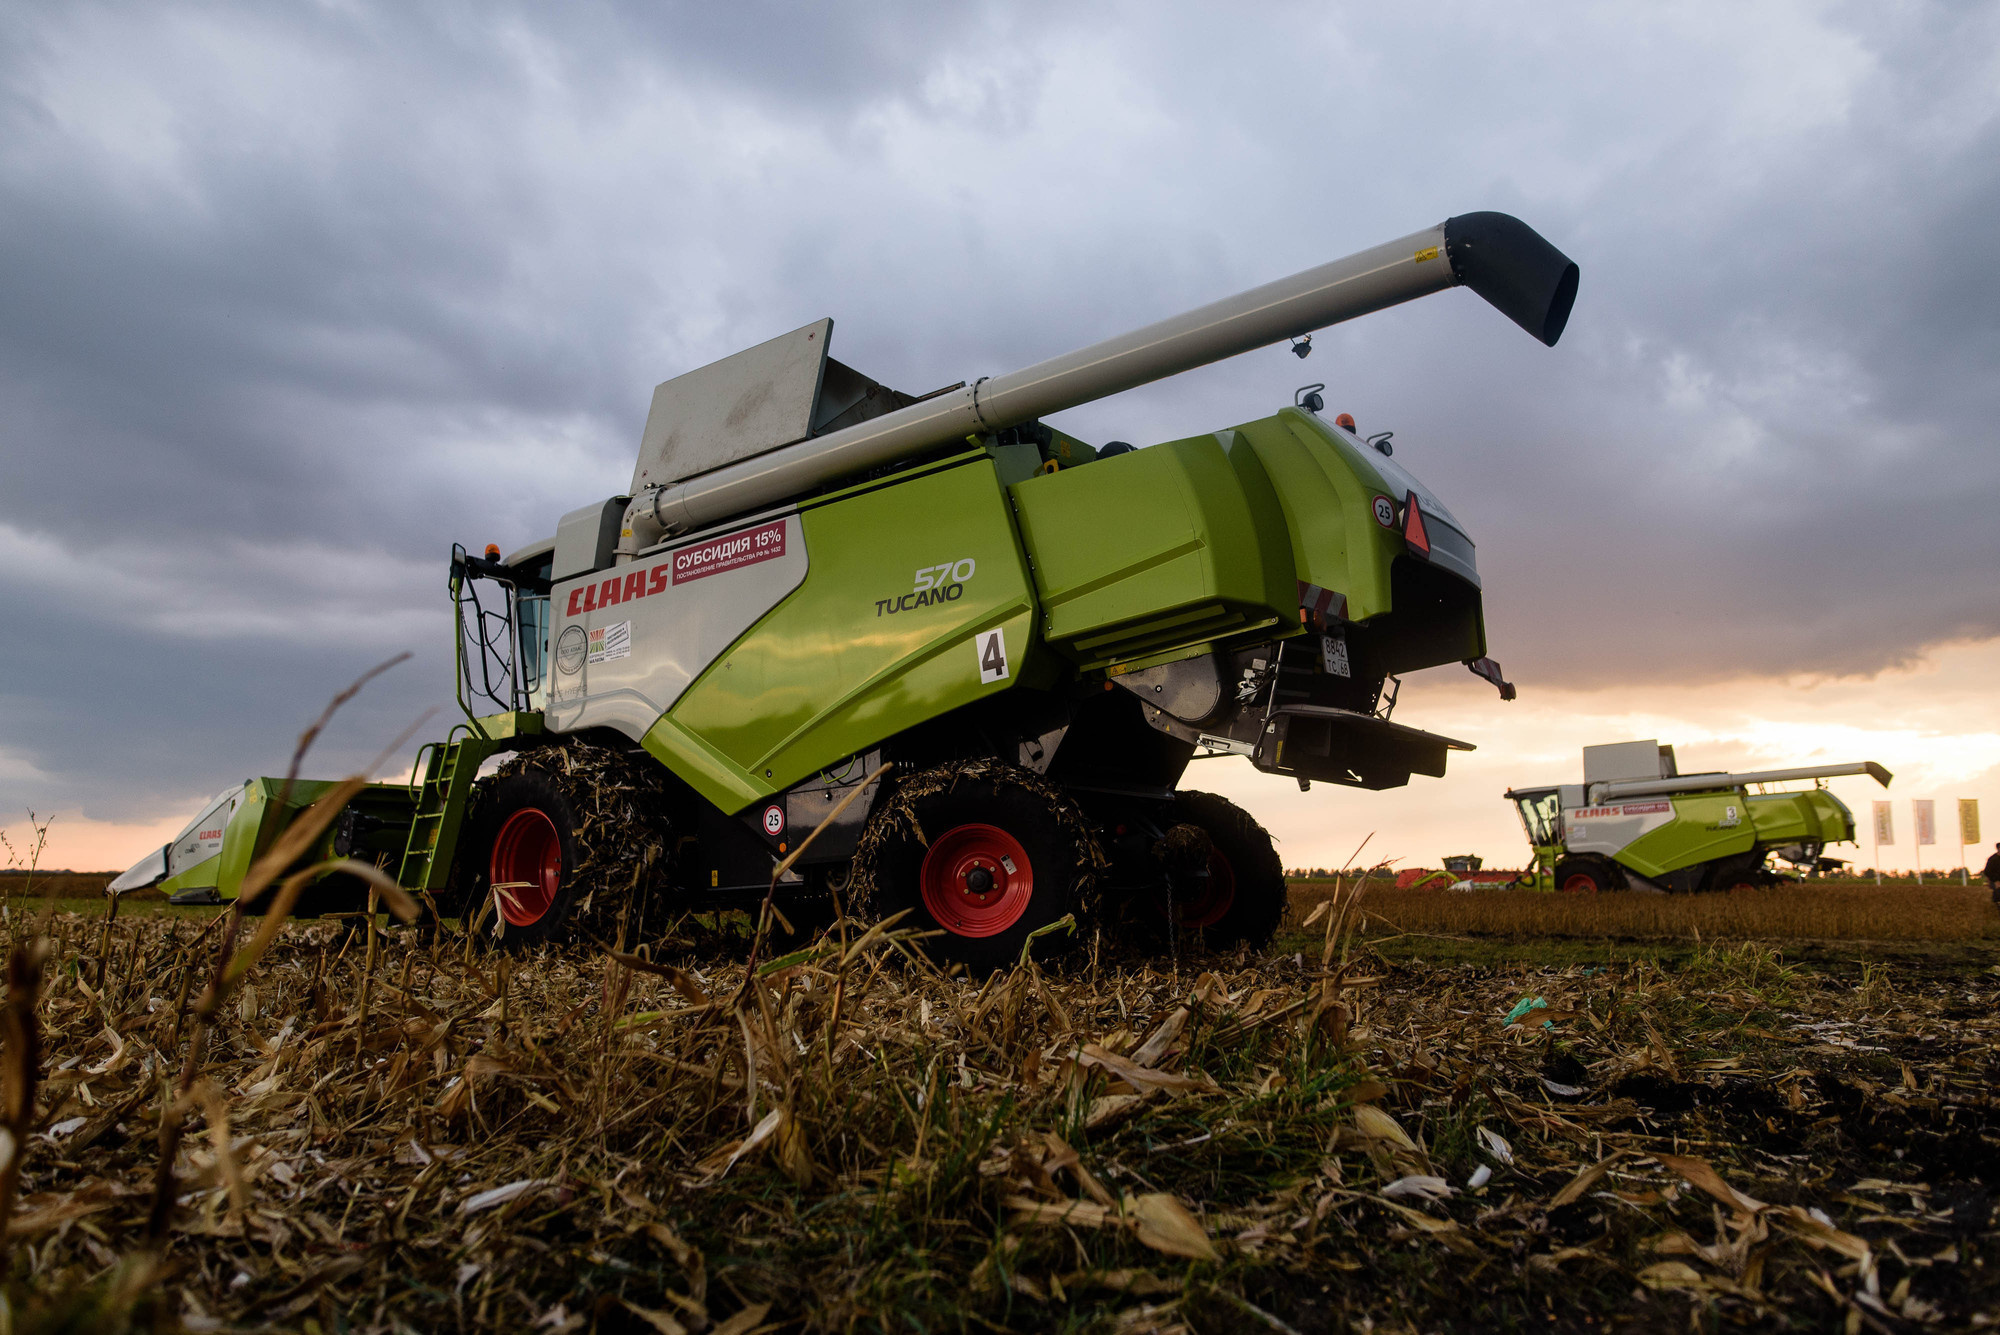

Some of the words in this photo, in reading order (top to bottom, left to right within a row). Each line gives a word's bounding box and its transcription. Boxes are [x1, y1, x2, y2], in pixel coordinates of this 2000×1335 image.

[1378, 504, 1391, 520] 25
[676, 536, 751, 570] СУБСИДИЯ
[754, 528, 782, 548] 15%
[676, 564, 716, 580] ПОСТАНОВЛЕНИЕ
[715, 553, 756, 568] ПРАВИТЕЛЬСТВА
[756, 550, 764, 558] РФ
[913, 558, 976, 593] 570
[566, 563, 669, 618] CLAAS
[875, 583, 963, 617] TUCANO
[981, 632, 1005, 677] 4
[1325, 638, 1345, 658] 8842
[1340, 662, 1349, 676] 68
[768, 813, 779, 827] 25
[1574, 806, 1620, 819] CLAAS
[1728, 806, 1736, 818] 3
[199, 829, 222, 840] CLAAS
